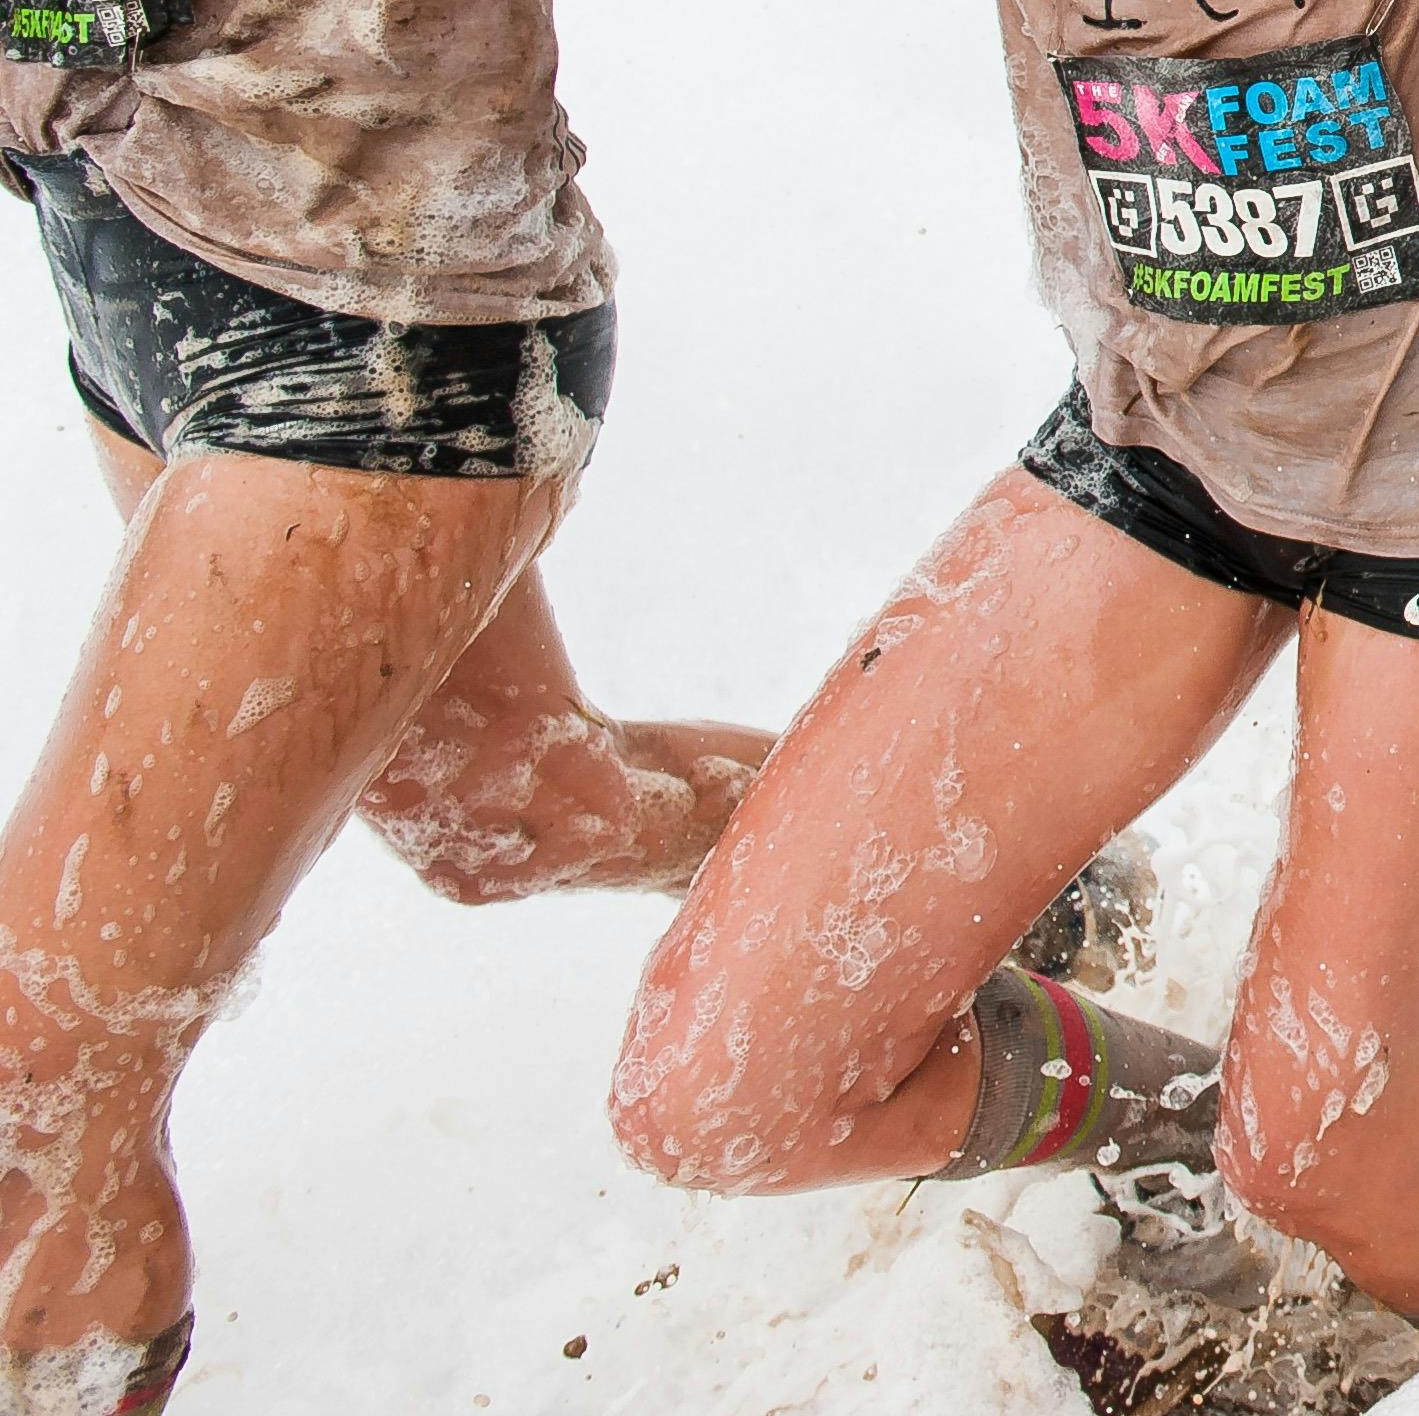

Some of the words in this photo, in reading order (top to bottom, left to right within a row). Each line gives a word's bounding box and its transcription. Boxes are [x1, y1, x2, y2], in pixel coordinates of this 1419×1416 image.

[1072, 81, 1222, 175] 5K
[1206, 61, 1388, 132] FOAM
[1077, 84, 1118, 97] THE
[1215, 105, 1392, 176] FEST
[1156, 177, 1323, 259] 5387
[1133, 263, 1350, 303] #5KFOAMFEST
